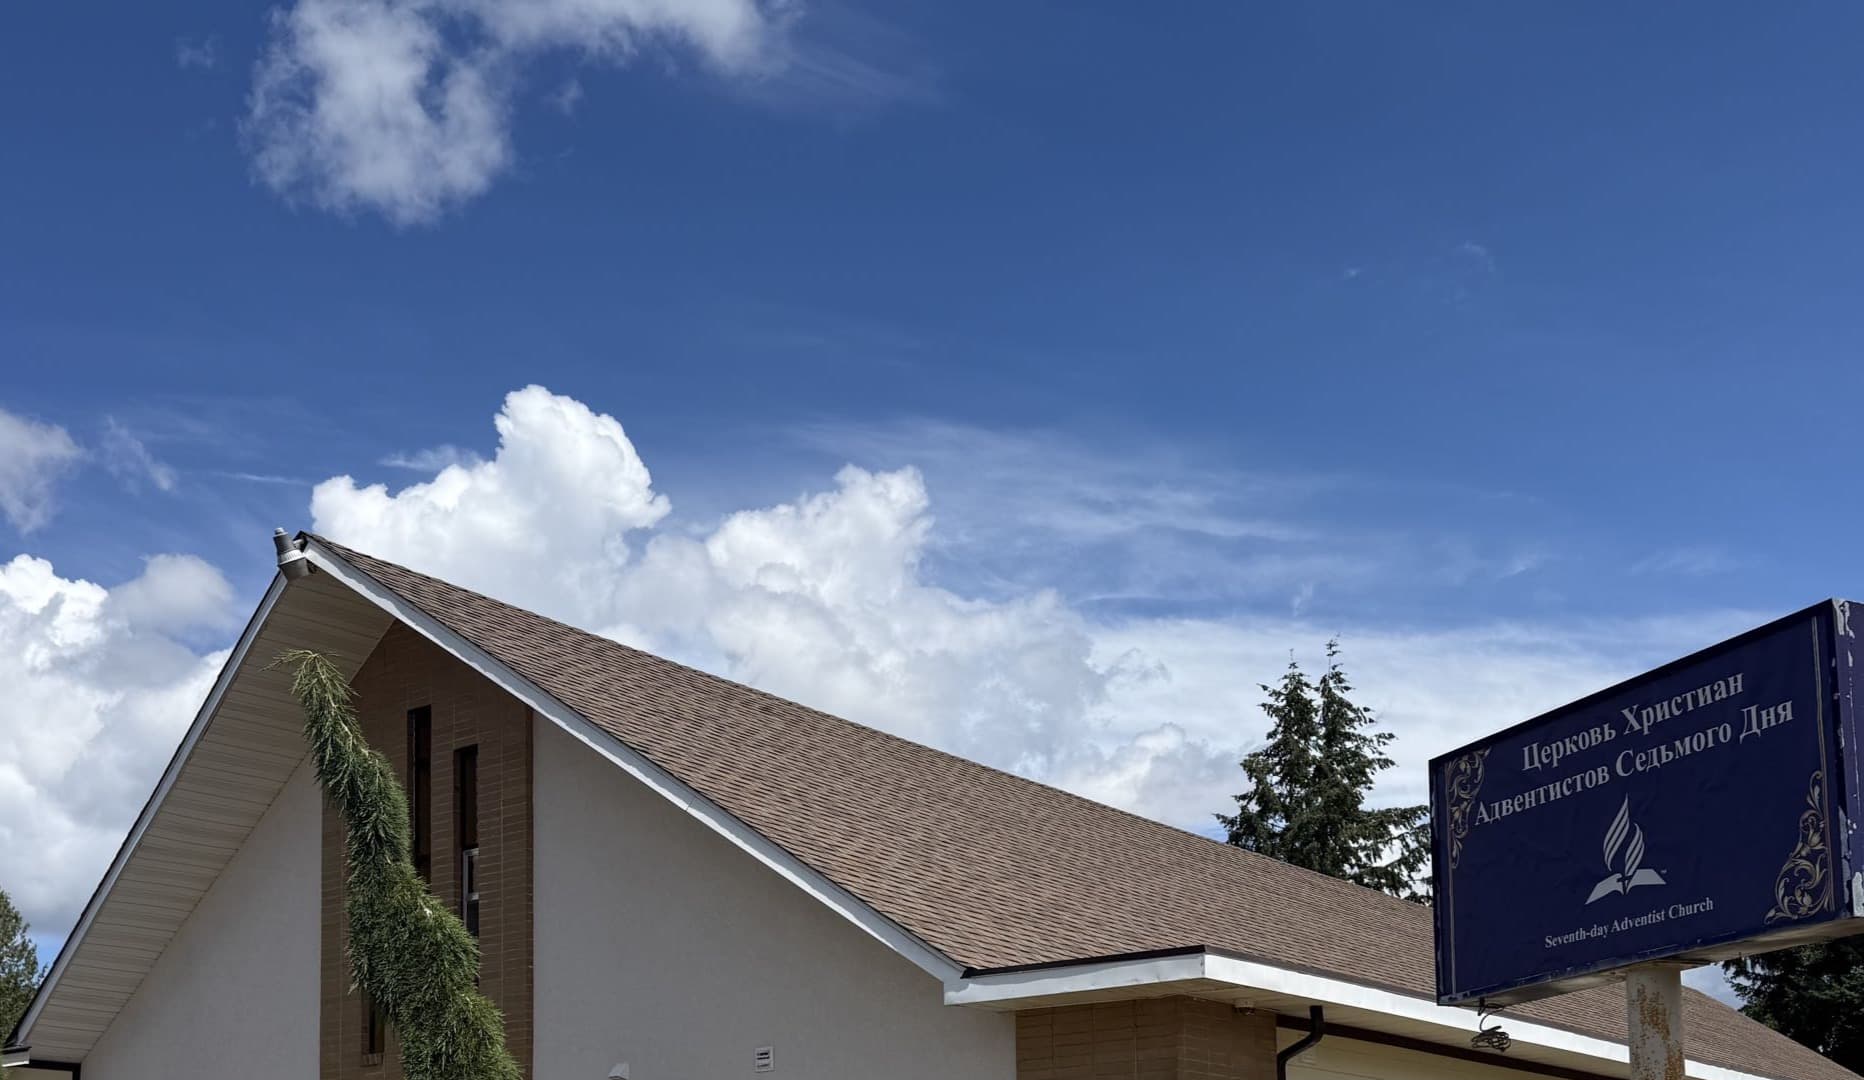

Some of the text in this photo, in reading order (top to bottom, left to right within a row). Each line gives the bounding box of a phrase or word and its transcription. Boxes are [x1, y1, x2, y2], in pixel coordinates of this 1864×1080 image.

[1475, 700, 1794, 825] Адвентистов Седьмого Дня
[1521, 673, 1744, 771] Церковь Христиан
[1545, 897, 1714, 948] Seventh-day Adventist Church
